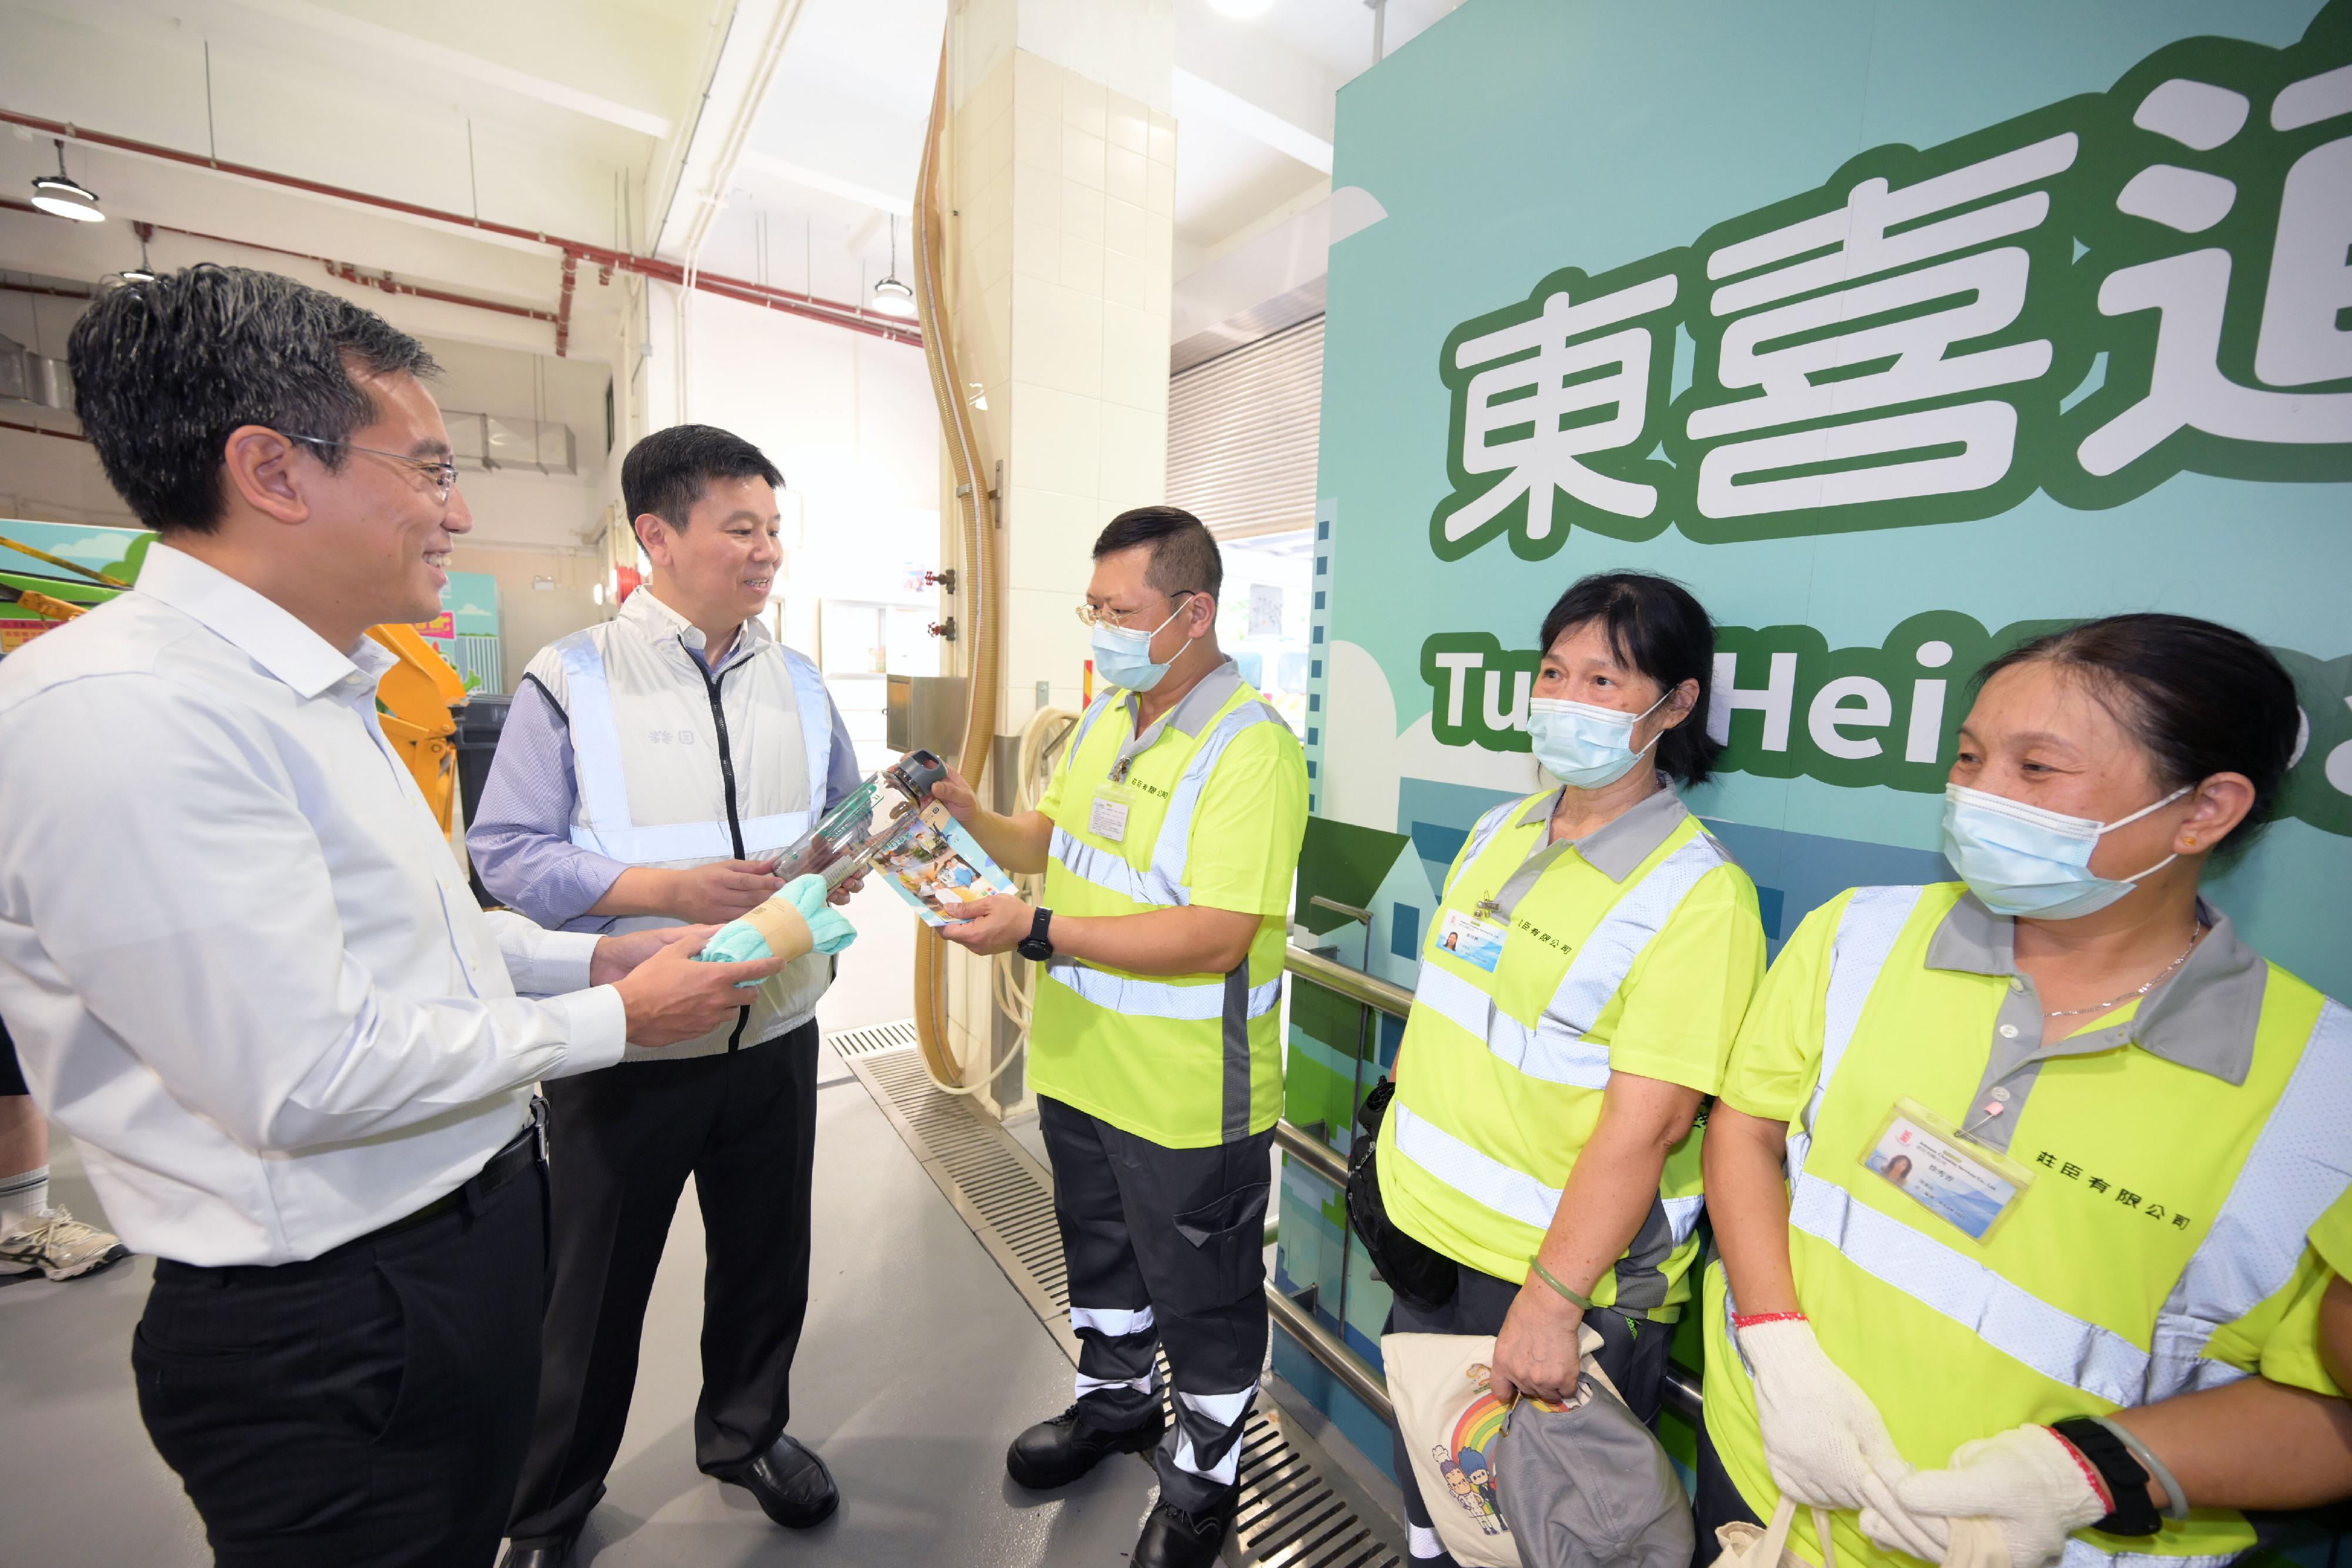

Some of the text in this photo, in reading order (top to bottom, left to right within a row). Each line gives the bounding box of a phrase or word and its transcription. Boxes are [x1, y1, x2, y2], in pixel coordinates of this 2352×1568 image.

[1435, 641, 1953, 763] Tu Hei
[1518, 919, 1572, 954] 臣有限公司
[2036, 1151, 2191, 1231] 莊臣有限公司
